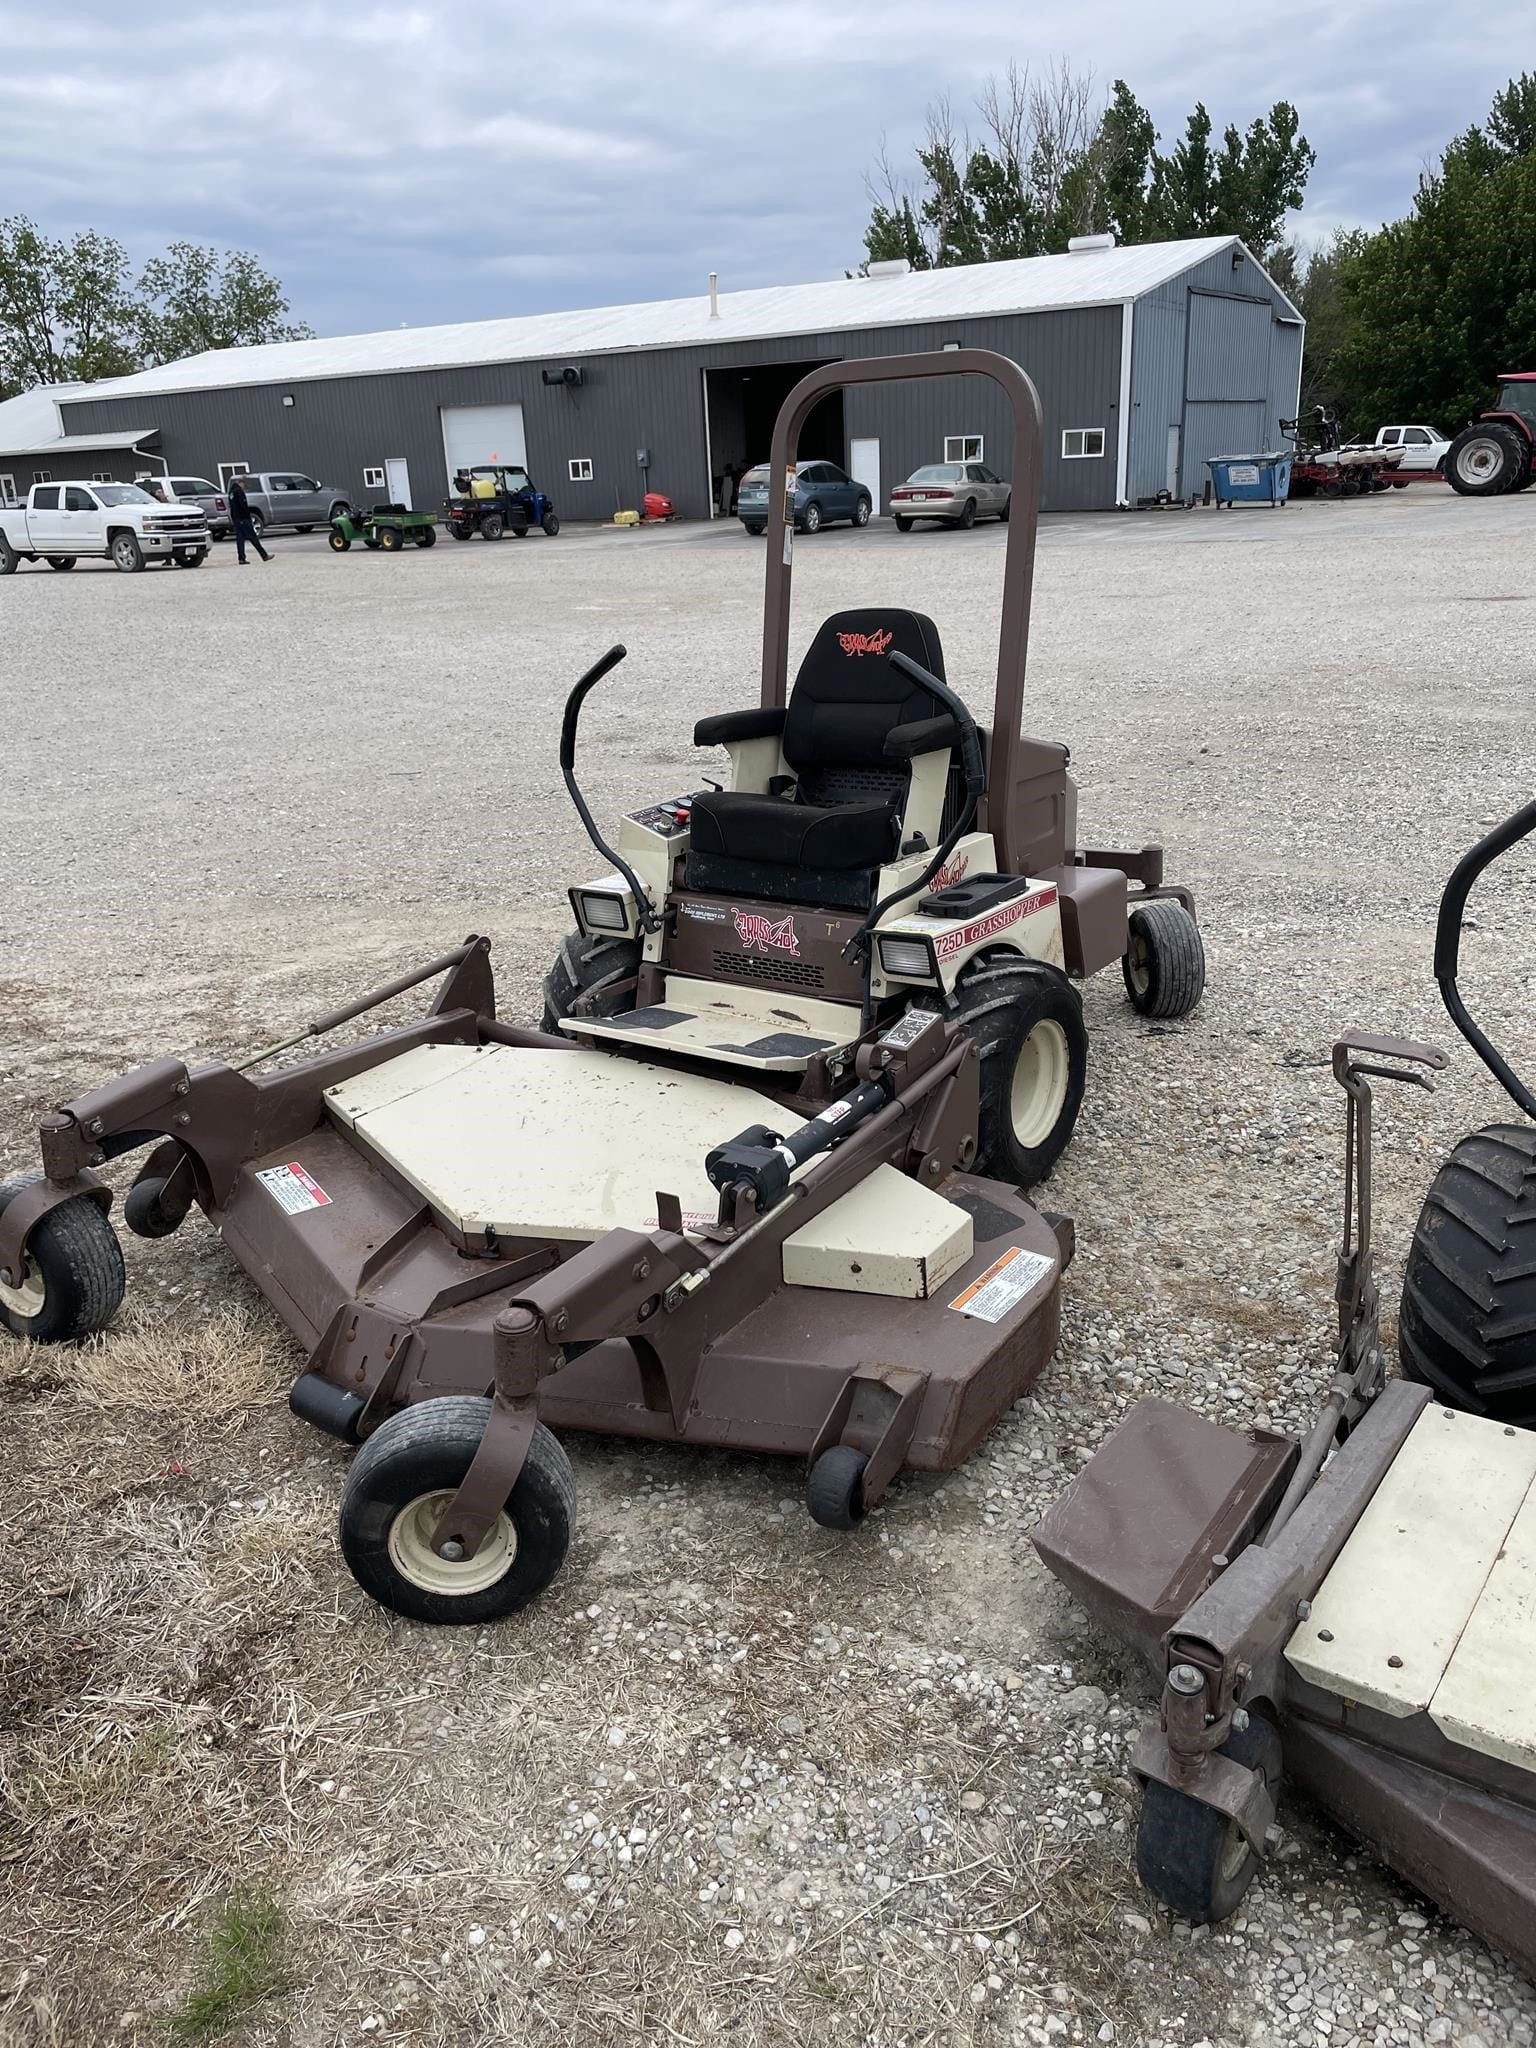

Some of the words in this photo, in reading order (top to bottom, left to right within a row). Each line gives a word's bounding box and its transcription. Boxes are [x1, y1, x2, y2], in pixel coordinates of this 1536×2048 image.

[970, 896, 1041, 941] GRASSHOPPER
[935, 932, 963, 956] 725D
[939, 953, 959, 966] DIESEL
